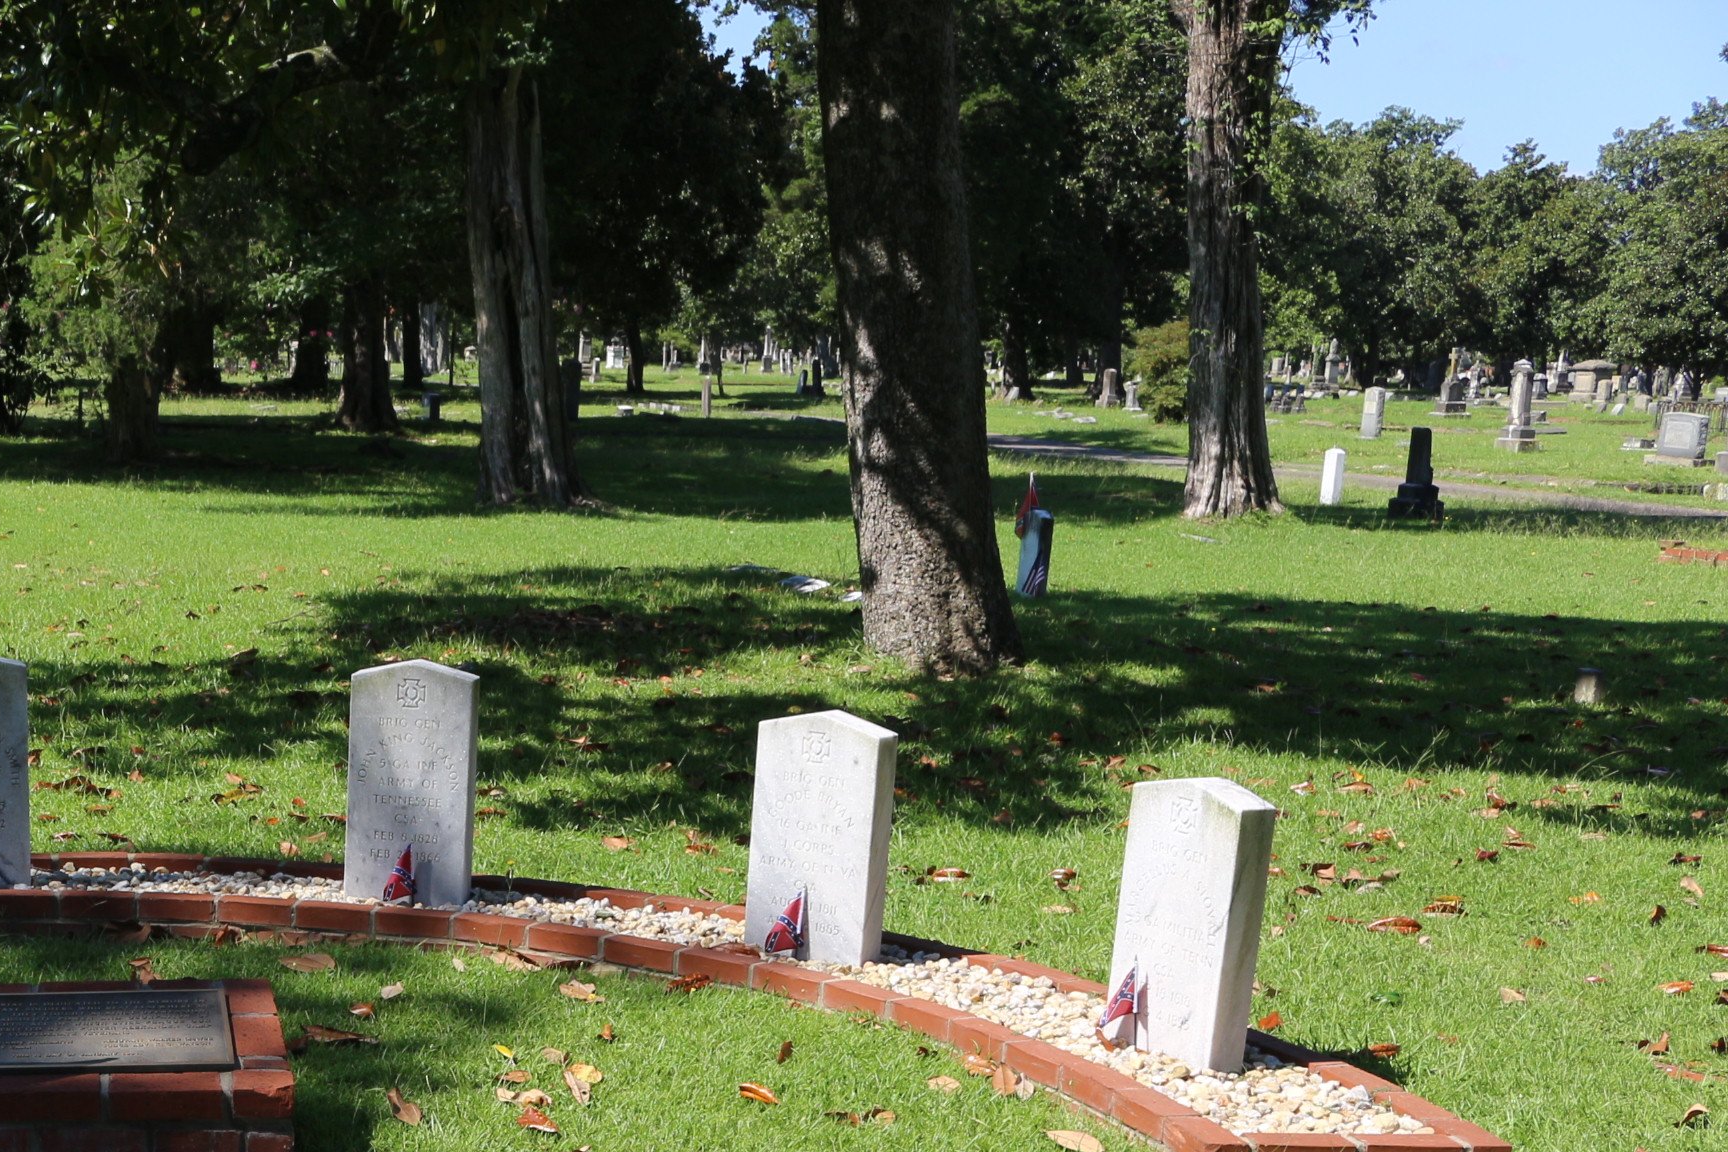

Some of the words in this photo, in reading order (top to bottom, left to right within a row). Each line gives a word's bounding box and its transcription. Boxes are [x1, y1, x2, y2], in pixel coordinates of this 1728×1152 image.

[378, 717, 408, 729] BRIG
[415, 718, 442, 730] GEN
[4, 746, 22, 788] SMITH
[357, 748, 377, 787] JOHN
[378, 732, 414, 751] KING
[420, 737, 462, 794] JACKSON
[379, 758, 387, 769] 5
[393, 759, 411, 770] GA
[417, 760, 438, 771] INF
[378, 777, 415, 788] ARMY
[421, 779, 438, 790] OF
[783, 770, 813, 785] BRIG
[818, 775, 845, 789] GEN
[372, 793, 442, 809] TENNESSEE
[767, 789, 811, 818] GOODE
[817, 790, 855, 829] BRYAN
[394, 813, 418, 825] CSA
[373, 830, 394, 842] FEB
[401, 833, 408, 843] 8
[413, 834, 439, 845] 1828
[821, 823, 842, 836] INF
[370, 848, 391, 860] FEB
[415, 852, 441, 864] 1866
[794, 840, 834, 856] CORPS
[1152, 839, 1179, 858] BRIG
[1183, 848, 1209, 865] GEN
[760, 855, 795, 869] ARMY
[801, 861, 818, 873] OF
[824, 864, 834, 875] N
[841, 866, 857, 881] VA
[819, 903, 839, 916] 1811
